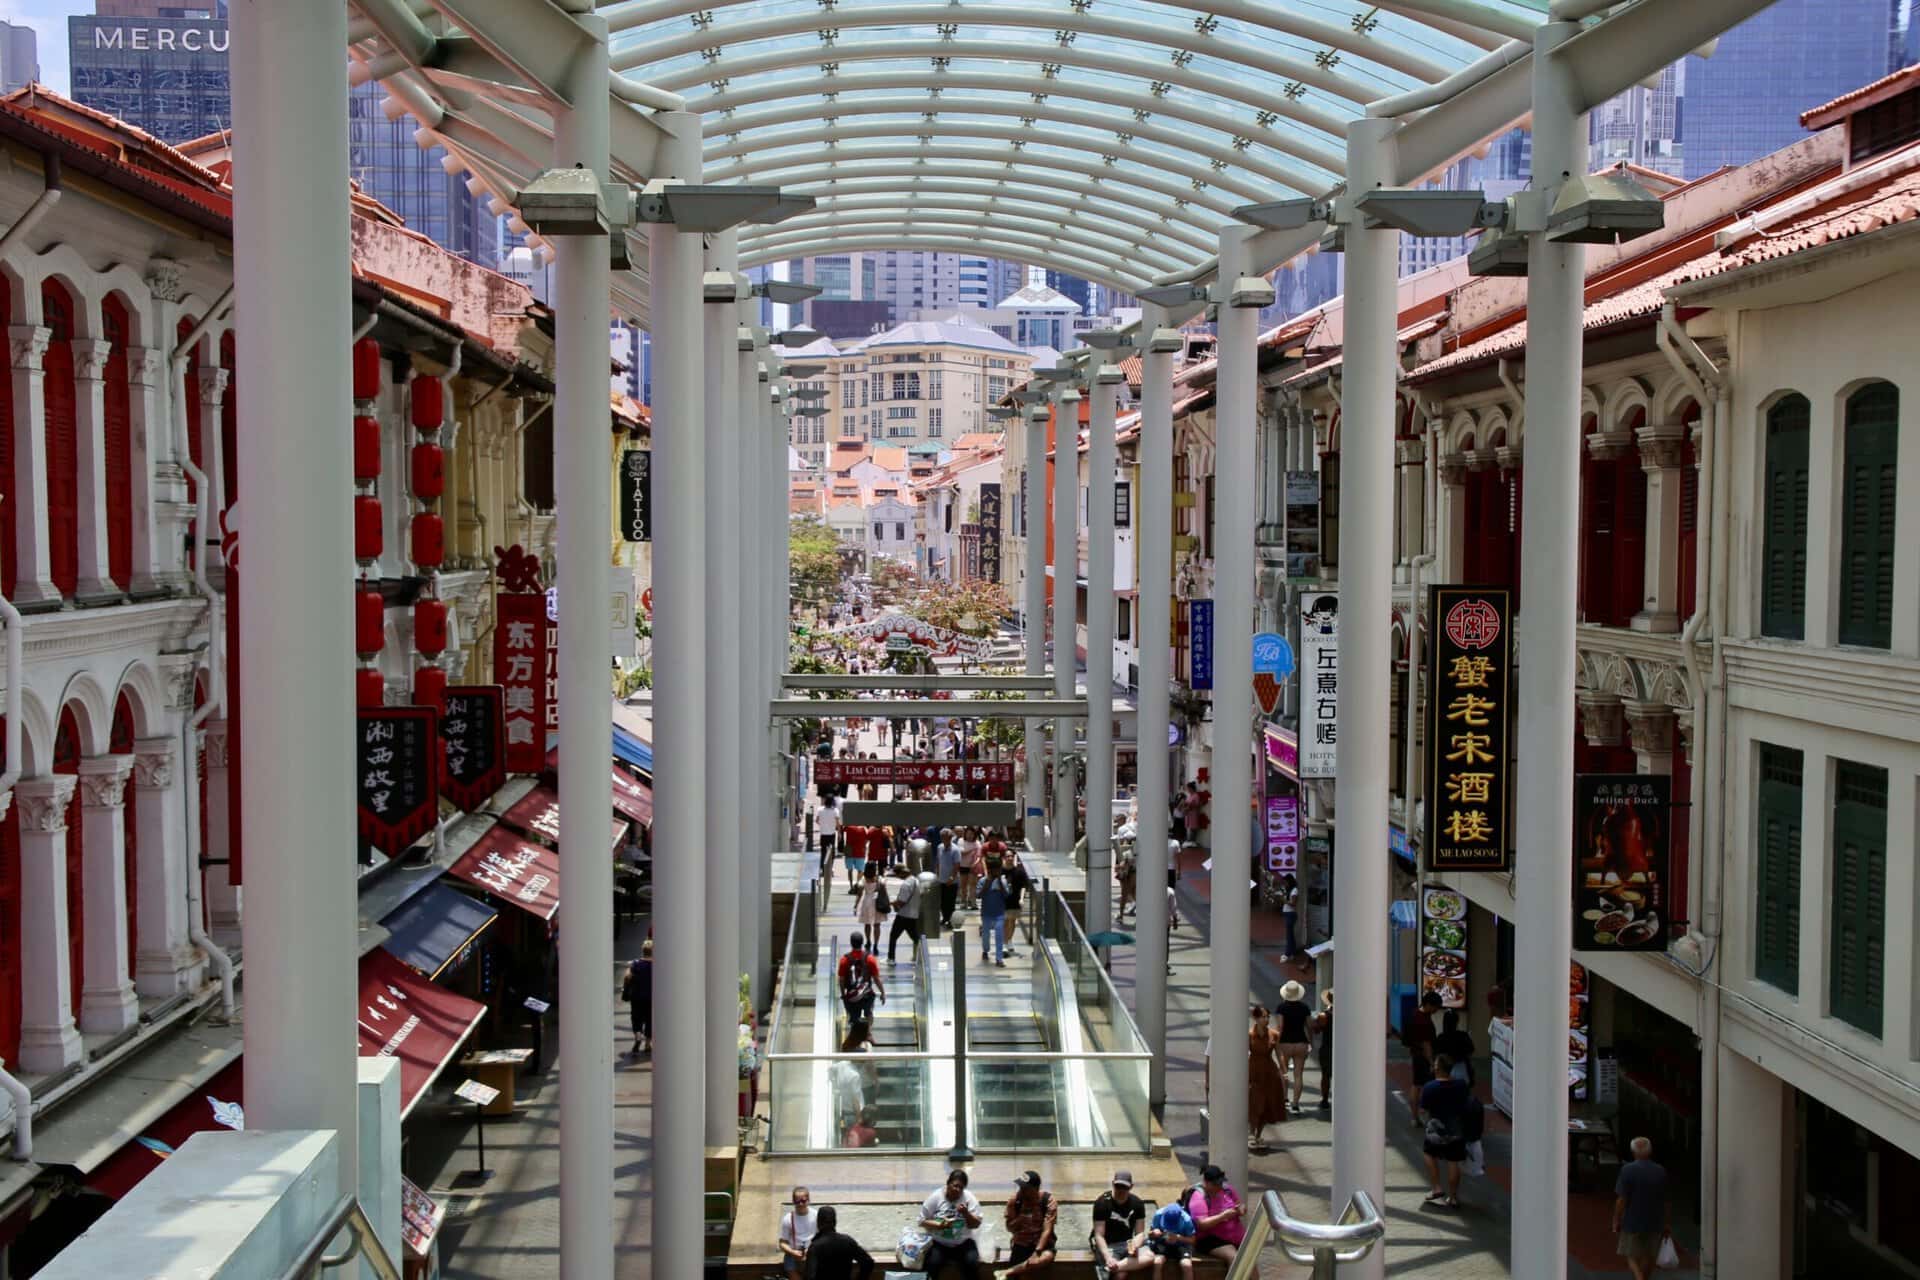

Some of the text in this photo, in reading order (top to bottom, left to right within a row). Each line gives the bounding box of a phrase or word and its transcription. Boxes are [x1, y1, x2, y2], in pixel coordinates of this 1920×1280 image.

[95, 27, 230, 52] MERCU
[632, 478, 644, 540] TATTOO
[506, 621, 535, 745] 东方美食
[1317, 647, 1337, 745] 左煮右烤
[1444, 655, 1497, 843] 蟹老宋酒楼
[1634, 796, 1659, 805] Duck
